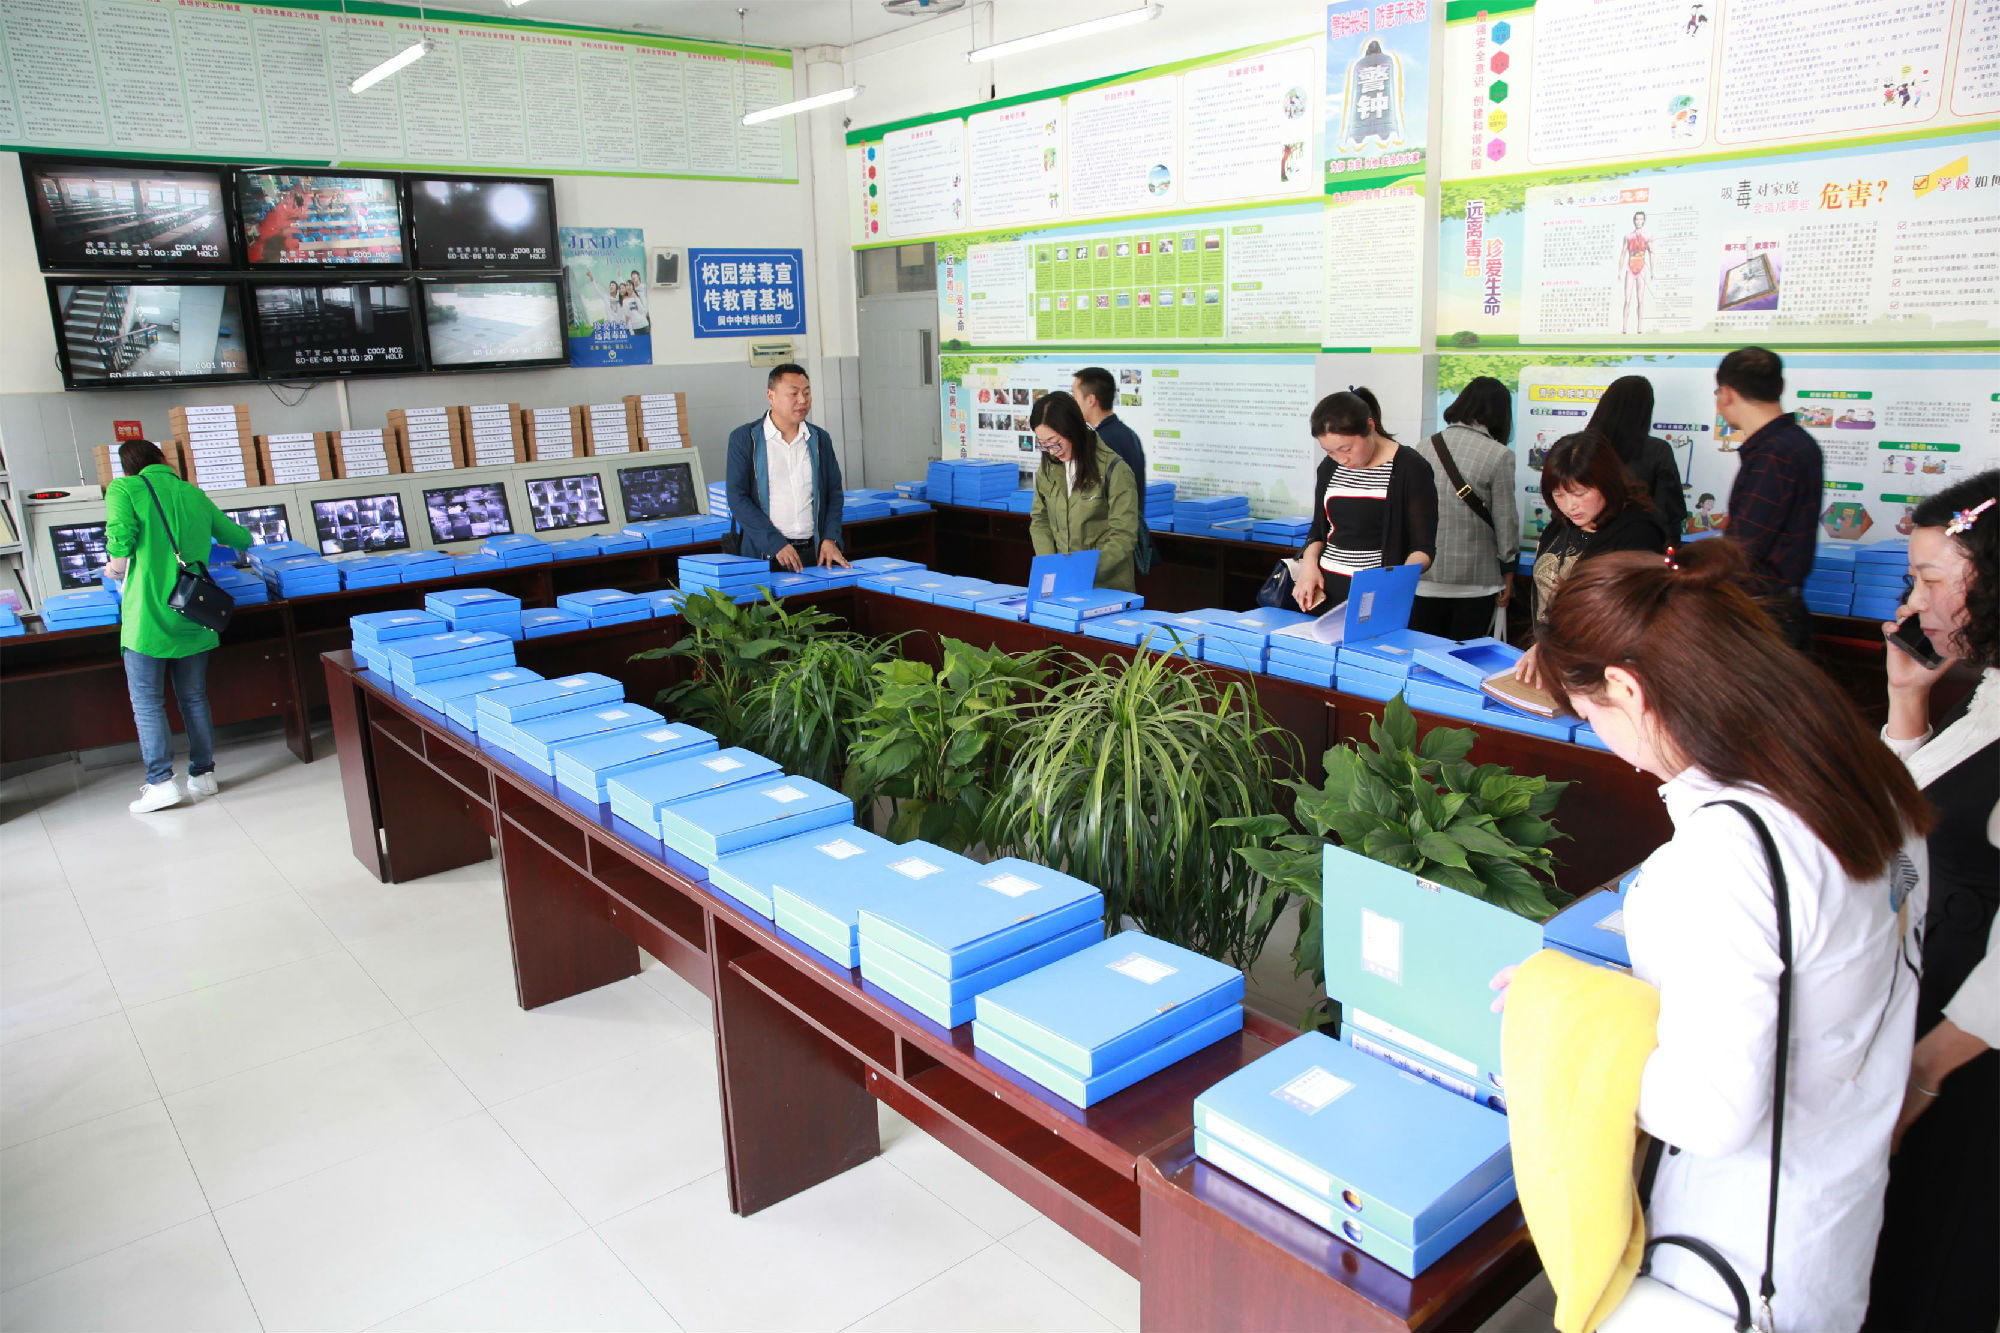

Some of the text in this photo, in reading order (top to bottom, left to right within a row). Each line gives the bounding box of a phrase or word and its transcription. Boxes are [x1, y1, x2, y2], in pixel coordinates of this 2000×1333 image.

[1356, 64, 1390, 120] 警钟
[1464, 200, 1485, 278] 远离毒品
[701, 262, 793, 285] 校园禁毒宣
[703, 288, 794, 312] 传教育基地
[1483, 238, 1504, 316] 珍爱生命
